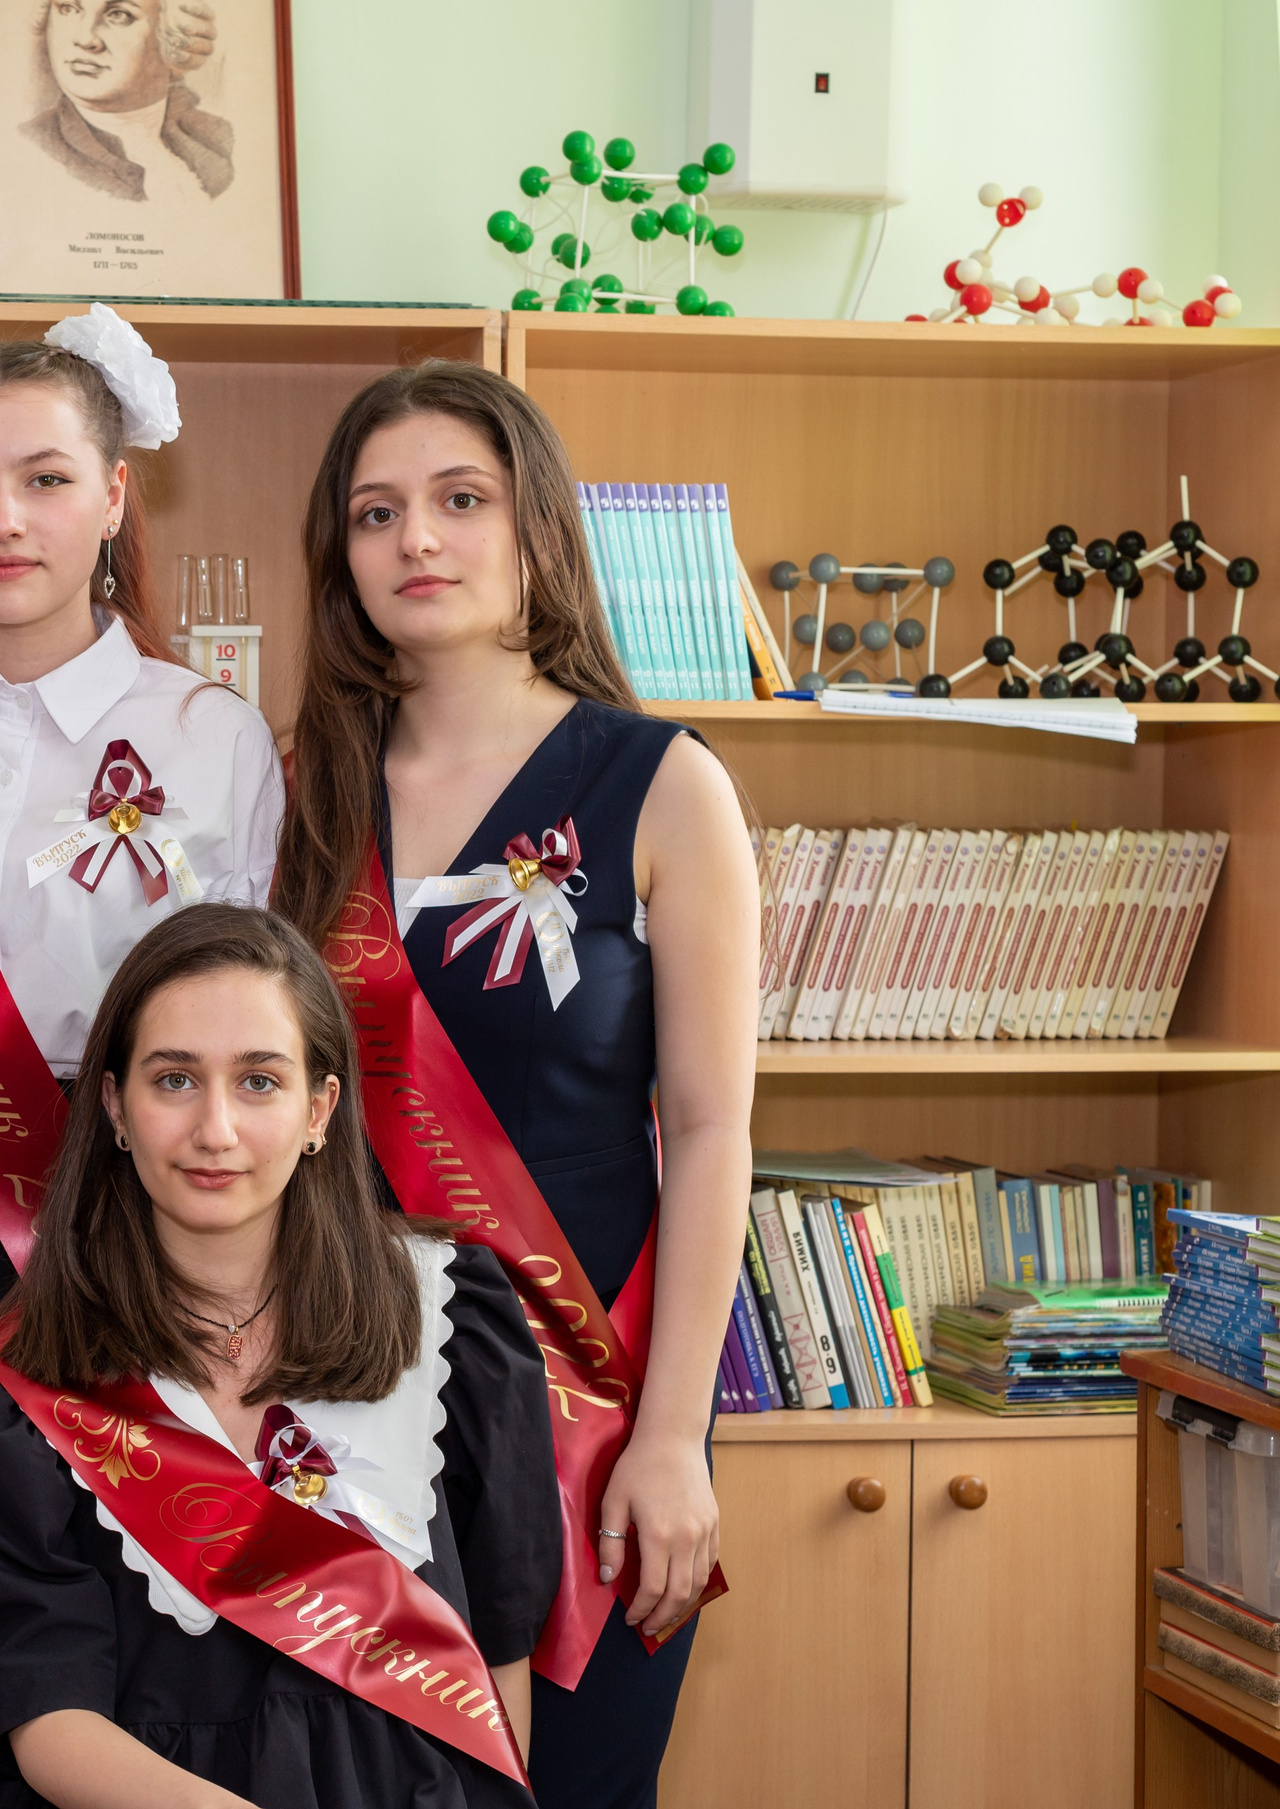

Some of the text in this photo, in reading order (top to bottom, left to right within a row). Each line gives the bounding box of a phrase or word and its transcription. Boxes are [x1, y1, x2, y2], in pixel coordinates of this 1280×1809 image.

[85, 232, 144, 242] ЛОМОНОСОВ
[216, 644, 236, 659] 10
[220, 669, 232, 683] 9
[32, 829, 87, 868] ВЫПУСК
[53, 844, 83, 868] 2022
[437, 875, 499, 893] ВЫПУСК
[453, 888, 485, 903] 2022
[322, 890, 500, 1236] Выпускник
[1137, 1191, 1145, 1202] 8
[1136, 1209, 1148, 1220] 11
[761, 1219, 777, 1256] ОБЩАЯ
[793, 1231, 810, 1273] ХИМИЯ
[737, 1311, 753, 1356] ПОДГОТОВКА
[848, 1254, 863, 1298] Проектная
[859, 1299, 878, 1355] деятельность
[874, 1356, 888, 1397] учащихся
[159, 1482, 510, 1732] Выпускник
